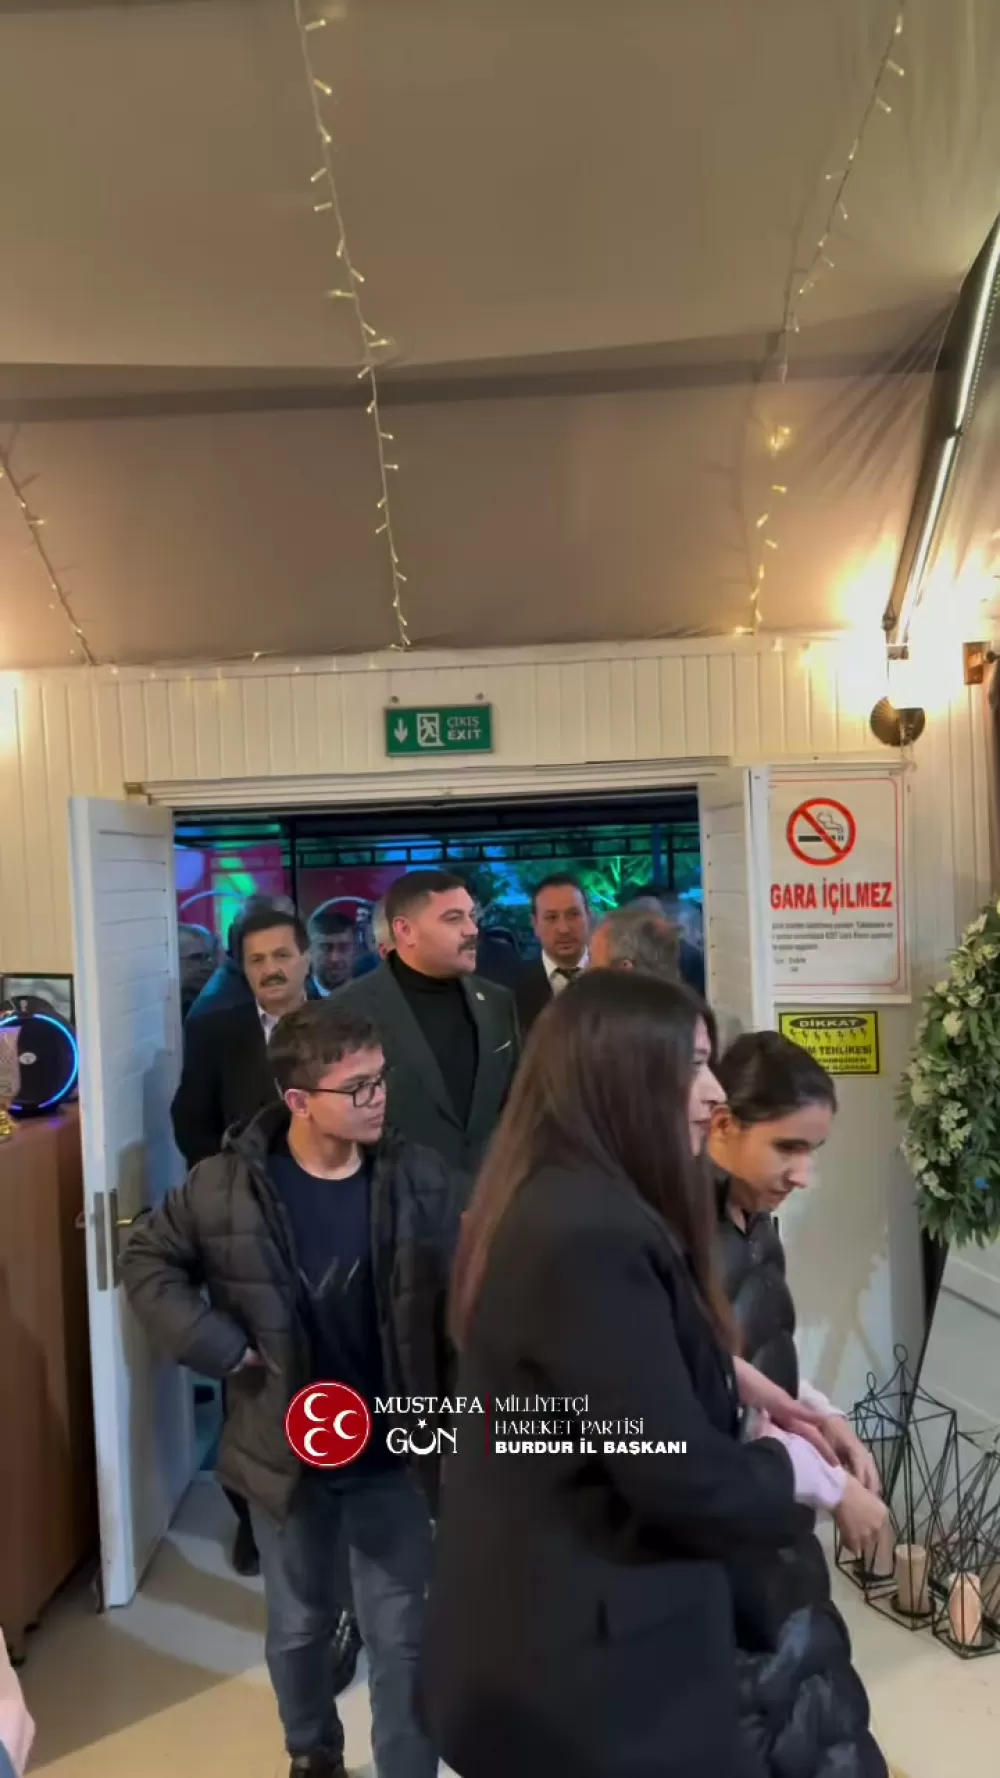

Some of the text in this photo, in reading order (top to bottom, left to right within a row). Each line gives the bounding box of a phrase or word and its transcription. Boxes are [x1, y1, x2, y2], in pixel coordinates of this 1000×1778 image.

[447, 729, 482, 740] EXIT
[770, 877, 893, 915] GARA İÇİLMEZ
[799, 1019, 858, 1028] DİKKAT
